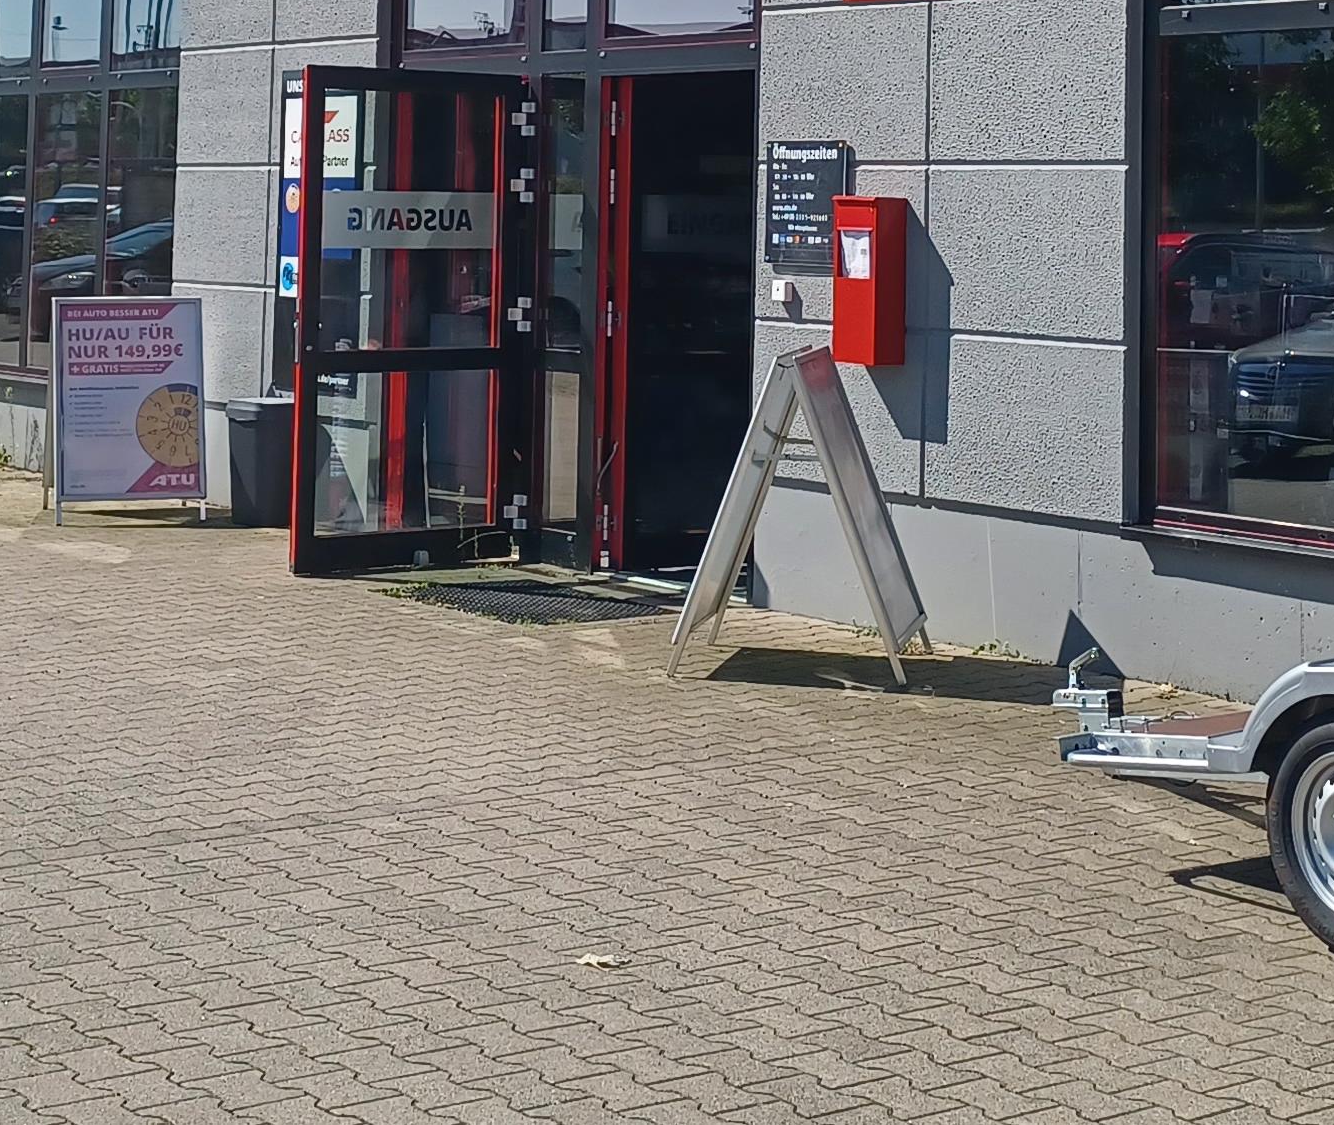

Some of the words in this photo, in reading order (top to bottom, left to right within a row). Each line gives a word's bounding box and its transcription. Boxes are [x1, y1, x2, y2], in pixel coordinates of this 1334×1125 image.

[772, 142, 838, 163] Öffnungszeiten
[109, 309, 140, 317] BESSER
[141, 308, 159, 316] ATU
[68, 327, 130, 342] HU/AU
[138, 323, 175, 341] FÜR
[68, 344, 109, 359] NUR
[82, 364, 119, 374] GRATIS
[171, 419, 187, 432] HU
[149, 473, 195, 487] ATU
